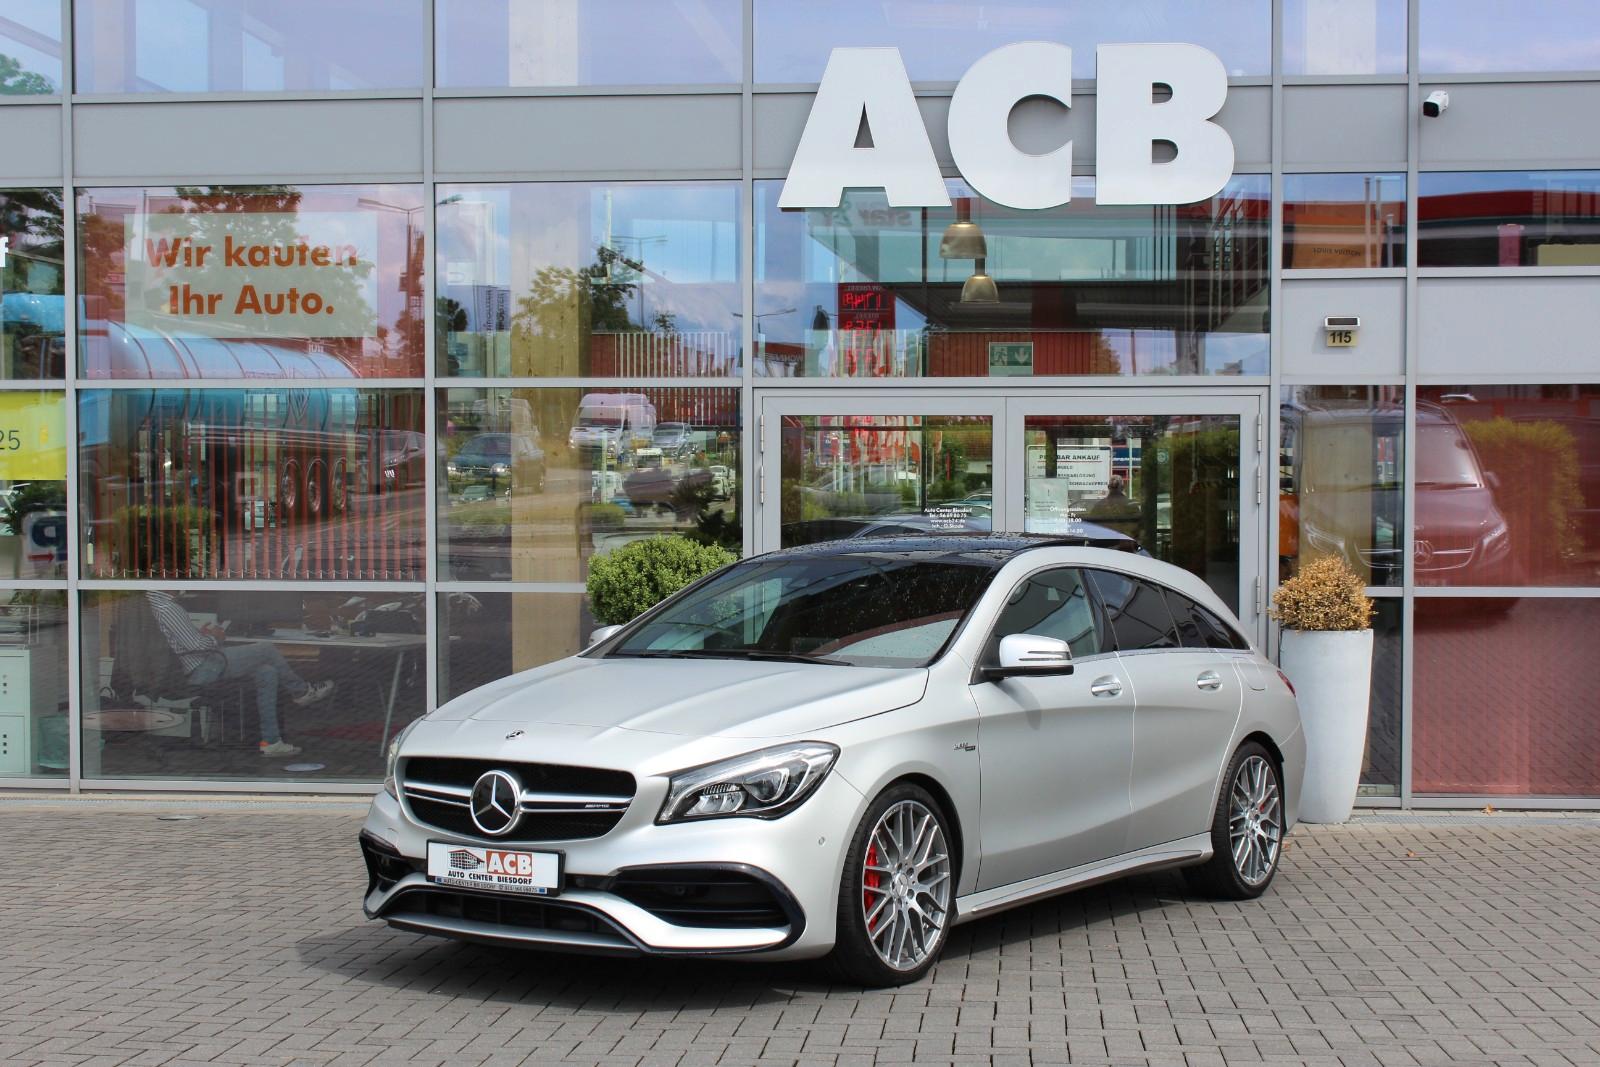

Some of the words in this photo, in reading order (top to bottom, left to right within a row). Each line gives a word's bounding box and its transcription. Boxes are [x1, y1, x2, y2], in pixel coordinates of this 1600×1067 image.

[777, 41, 1236, 210] ACB
[146, 236, 212, 267] Wir
[224, 234, 358, 267] kaufen
[169, 283, 223, 315] Ihr
[234, 284, 334, 315] Auto.
[1329, 331, 1352, 343] 115
[448, 870, 465, 879] AUTO
[468, 872, 493, 882] CENTER
[497, 876, 533, 885] BIESDORF
[488, 852, 532, 876] ACB
